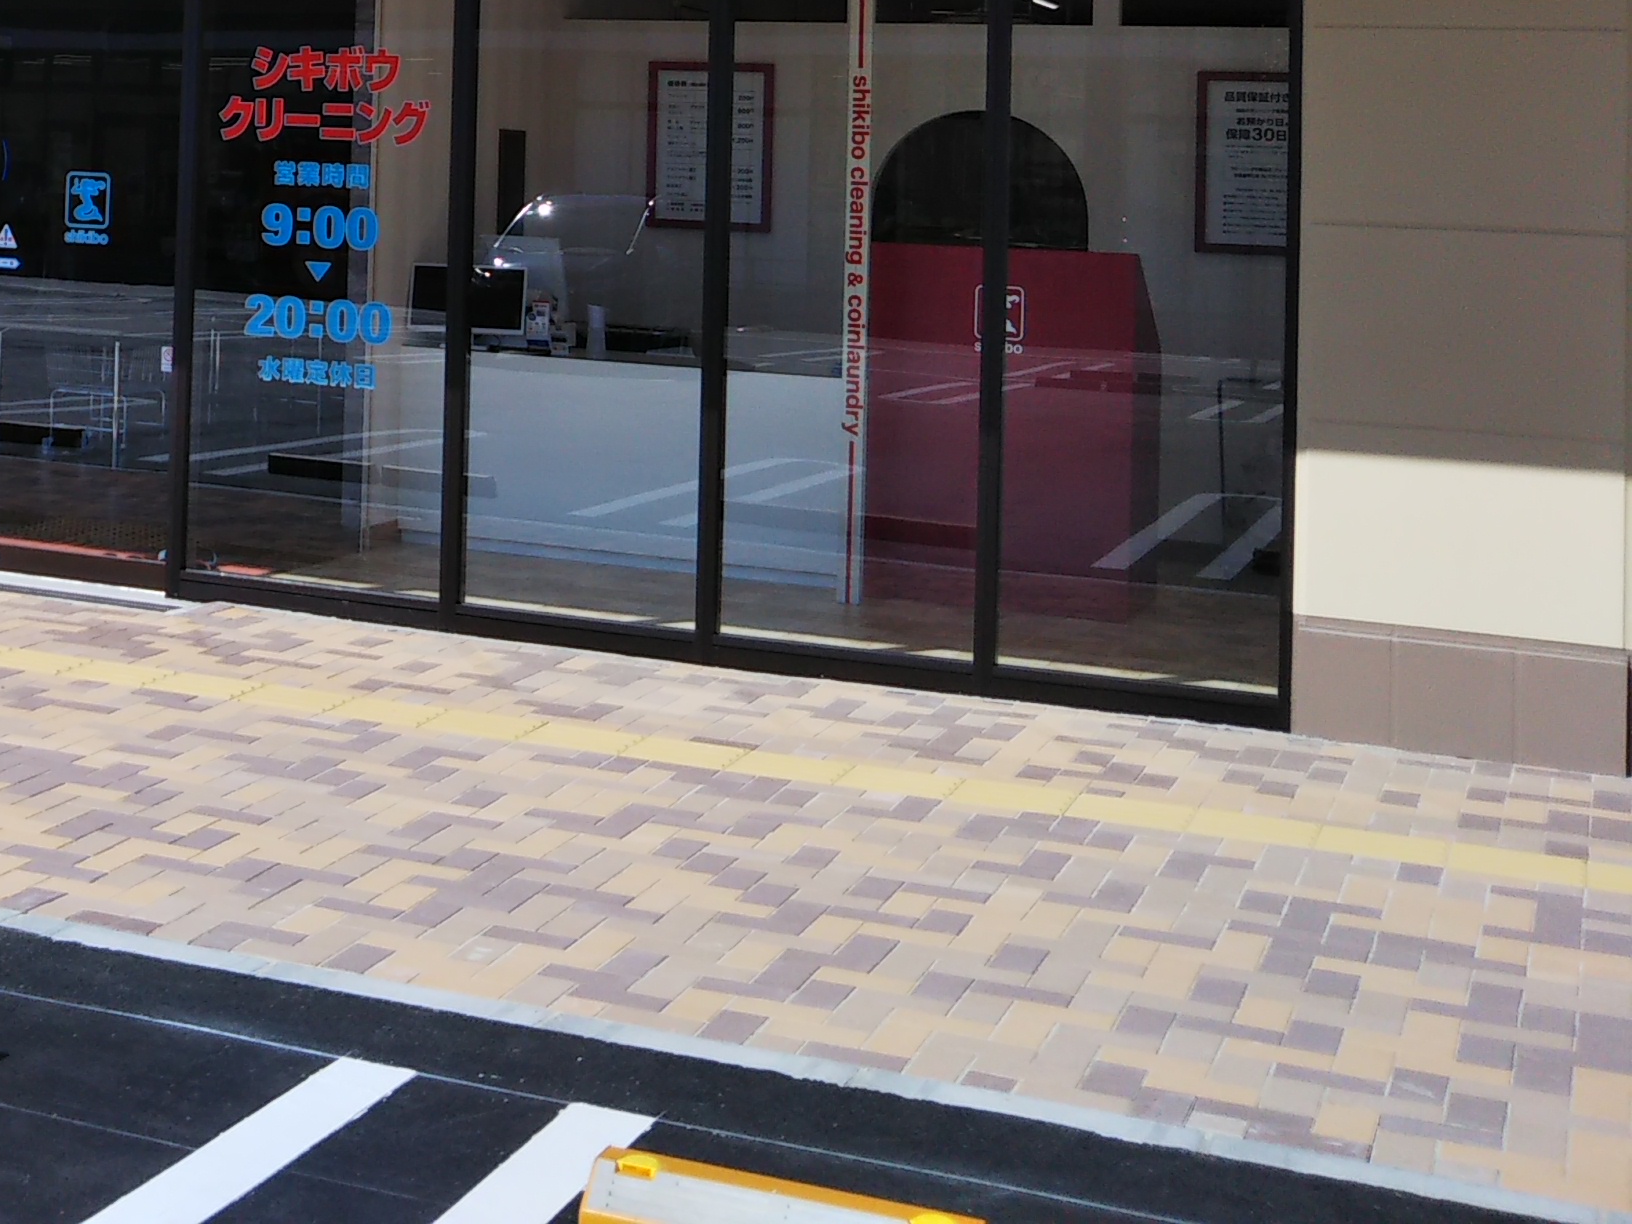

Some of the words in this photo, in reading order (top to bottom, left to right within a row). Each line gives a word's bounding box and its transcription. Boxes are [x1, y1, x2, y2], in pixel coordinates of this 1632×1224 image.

[251, 45, 401, 93] シキボウ
[219, 95, 431, 145] クリーニング
[850, 74, 872, 161] shikibo
[274, 160, 371, 189] 営業時間
[261, 203, 379, 251] 9:00
[845, 166, 868, 265] cleaning
[847, 271, 863, 287] &
[244, 293, 392, 345] 20:00
[258, 355, 377, 390] 水曜定休日
[841, 294, 865, 437] coinlaundry
